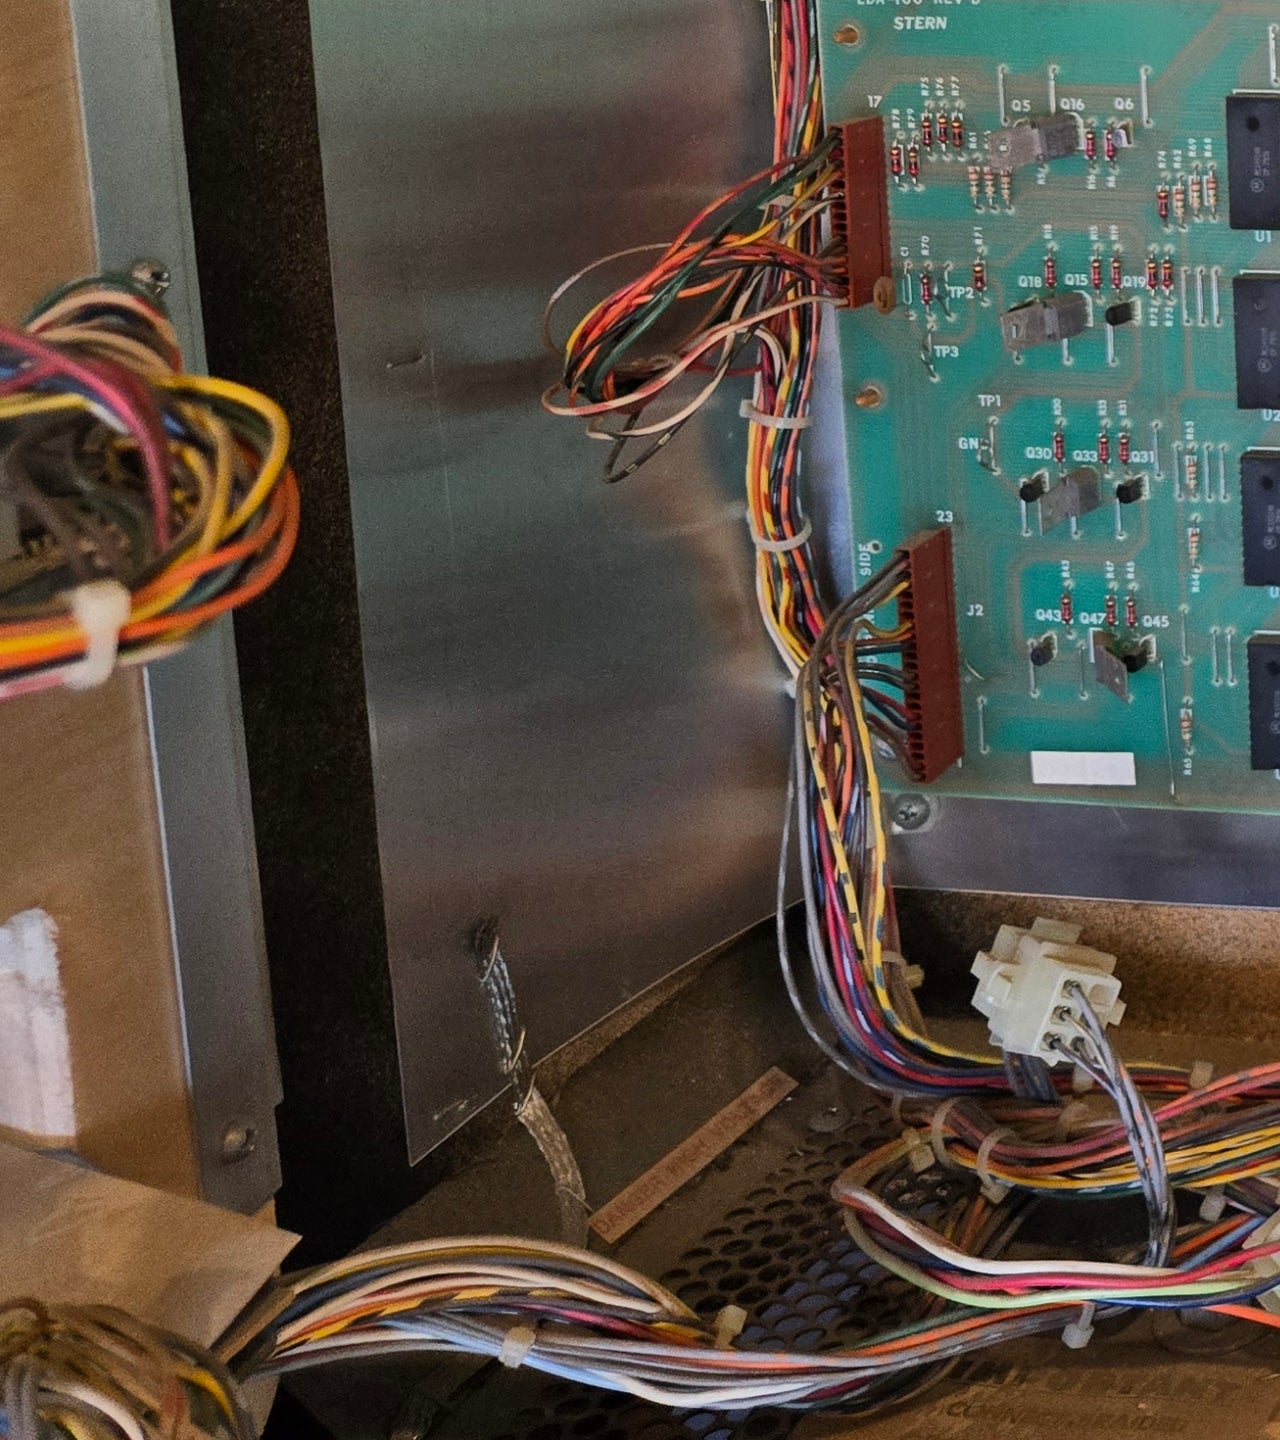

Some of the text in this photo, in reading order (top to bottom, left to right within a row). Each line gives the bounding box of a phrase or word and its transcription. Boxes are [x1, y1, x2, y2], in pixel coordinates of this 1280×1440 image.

[893, 15, 948, 31] STERN
[1059, 97, 1086, 112] Q16
[933, 345, 960, 358] TP3
